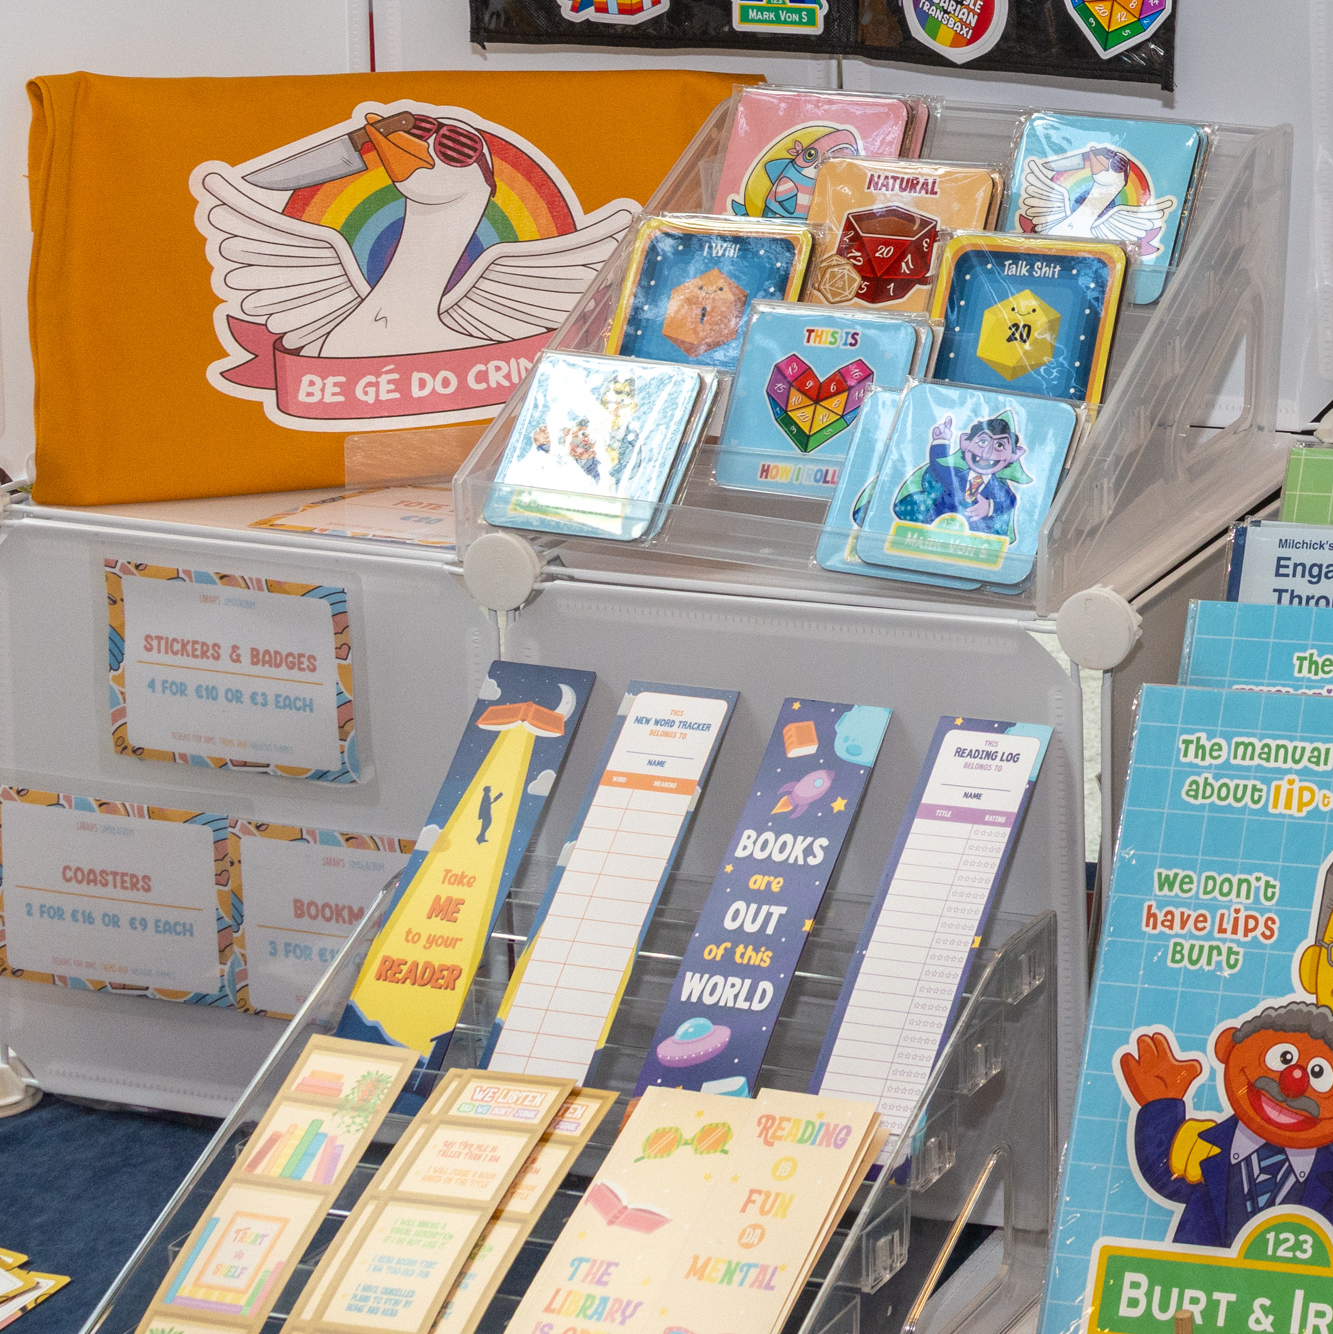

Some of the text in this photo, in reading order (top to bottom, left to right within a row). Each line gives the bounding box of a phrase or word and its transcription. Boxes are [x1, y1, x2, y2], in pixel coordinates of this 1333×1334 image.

[867, 173, 939, 196] NATURAL
[299, 374, 346, 403] BE
[411, 370, 457, 398] DO
[467, 357, 540, 390] CRI
[143, 635, 317, 674] STICKERS & BADGES
[148, 678, 314, 714] 4 FOR €10 OR €3 EACH
[632, 714, 712, 734] NEW WORD TRACKER
[954, 746, 1020, 764] READING LOG
[1183, 777, 1264, 808] about
[1270, 778, 1316, 813] lip
[734, 828, 830, 867] BOOKS
[62, 865, 152, 893] COASTERS
[441, 868, 478, 888] Take
[748, 871, 784, 892] are
[426, 895, 465, 922] ME
[724, 900, 788, 936] OUT
[404, 928, 464, 952] to your
[702, 941, 772, 968] of this
[374, 955, 462, 992] READER
[680, 972, 775, 1012] WORLD
[756, 1114, 852, 1150] READING
[739, 1188, 794, 1220] FUN
[1266, 1233, 1313, 1259] 123
[684, 1254, 779, 1291] MENTAL
[1248, 1297, 1274, 1333] &
